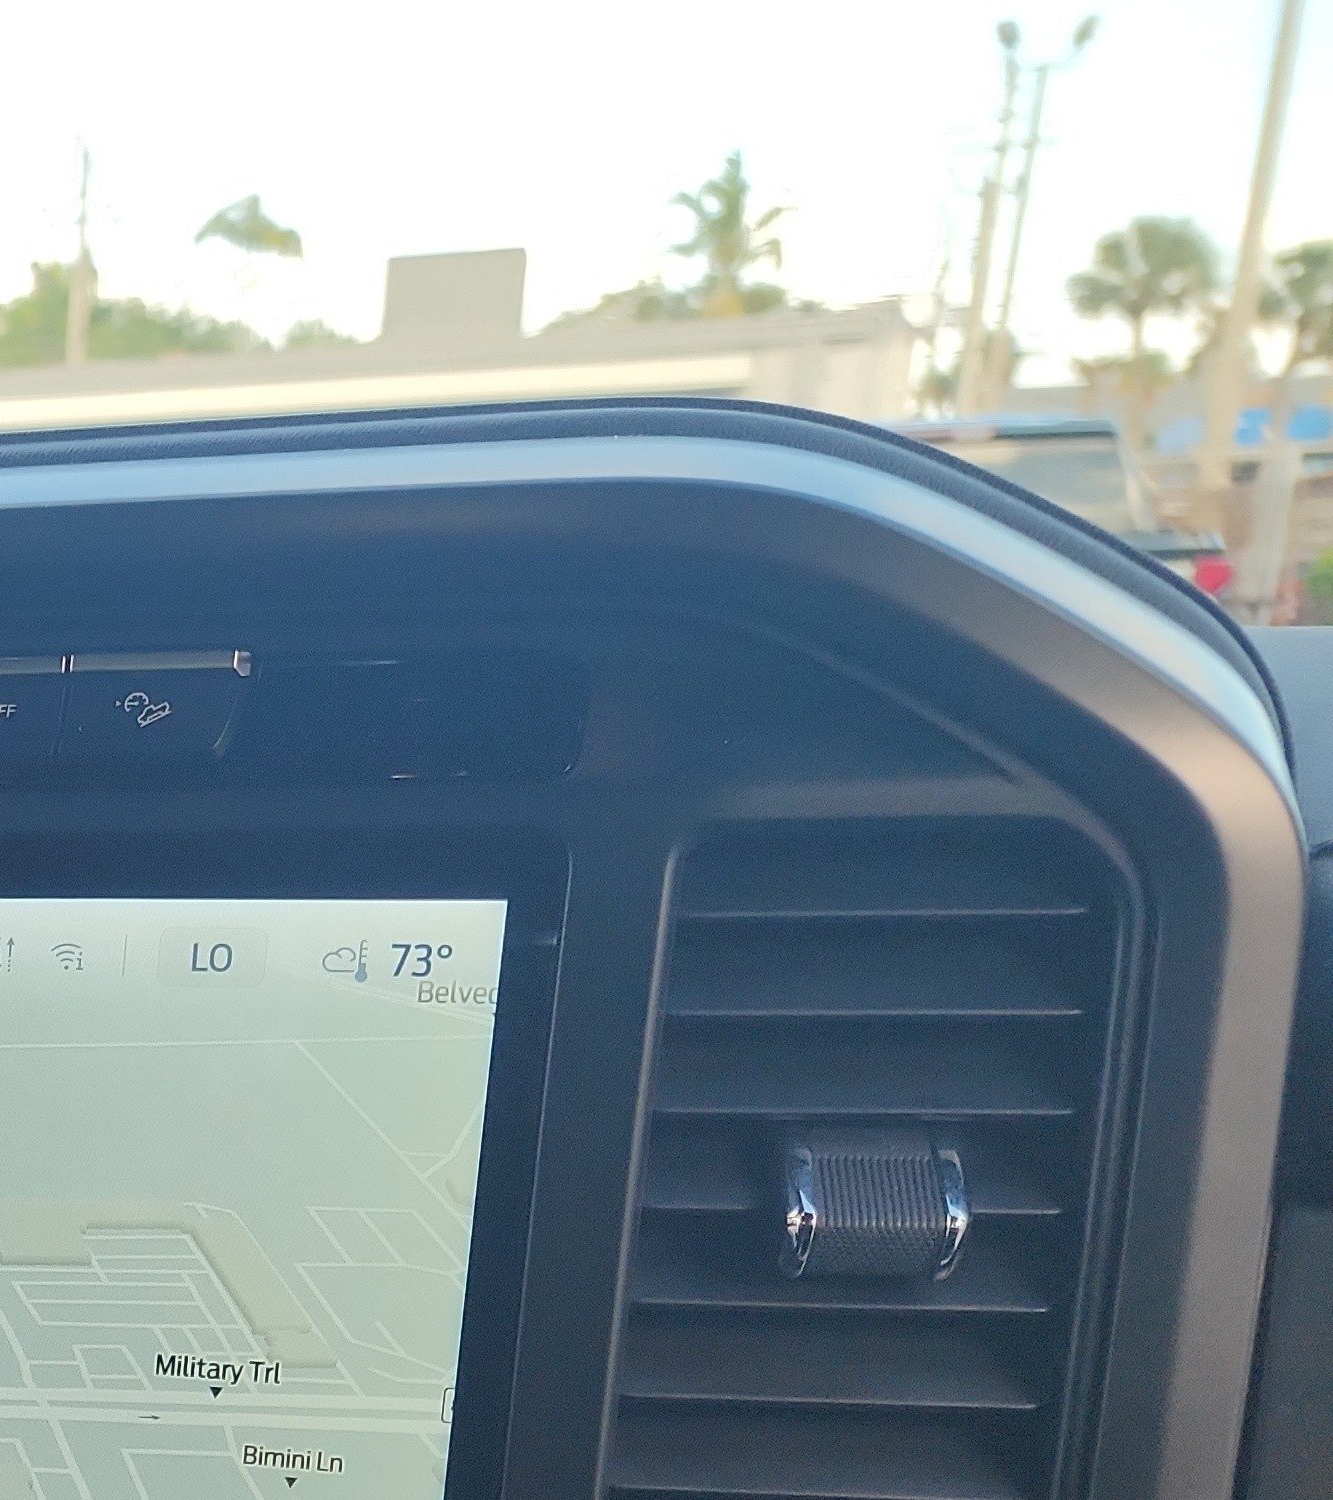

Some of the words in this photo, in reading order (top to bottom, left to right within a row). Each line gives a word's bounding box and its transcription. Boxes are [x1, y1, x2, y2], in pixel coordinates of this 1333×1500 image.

[190, 942, 233, 973] LO
[391, 943, 454, 978] 73°
[154, 1353, 244, 1387] Military
[247, 1361, 281, 1385] Trl
[242, 1443, 310, 1473] Bimini
[315, 1450, 344, 1474] Ln
